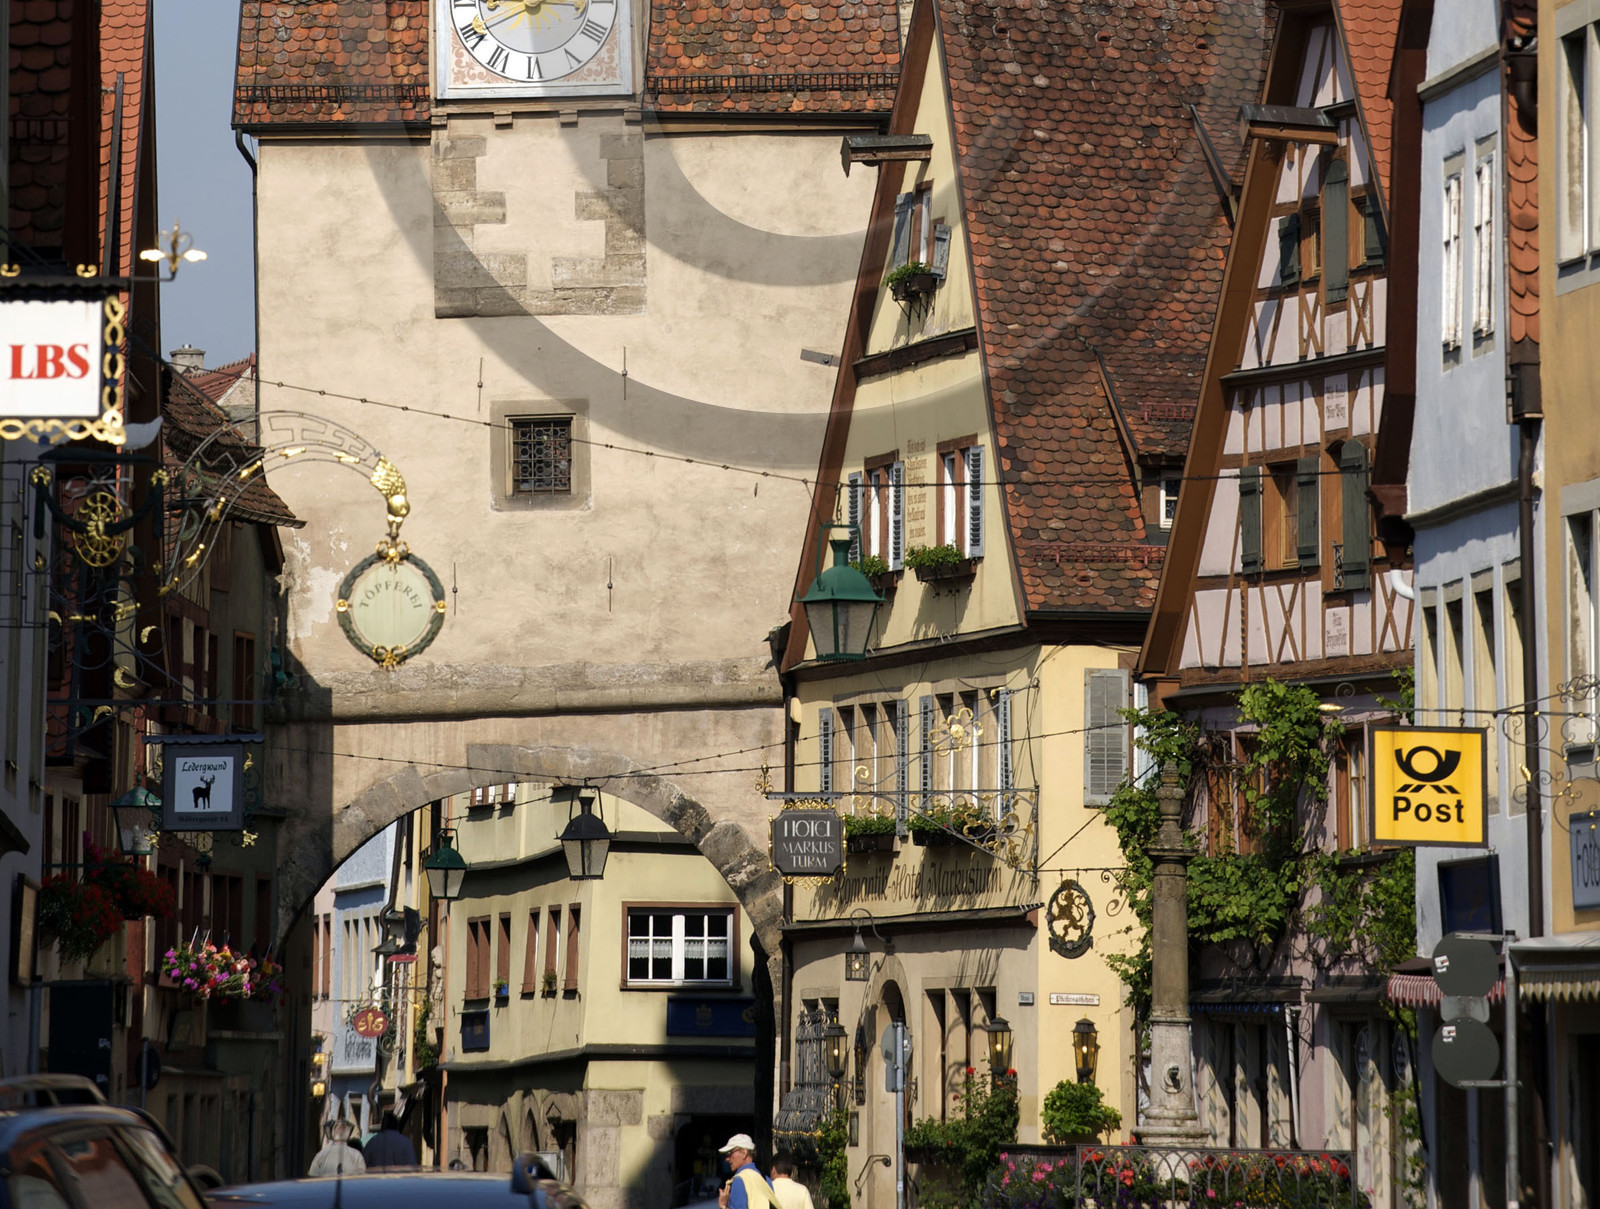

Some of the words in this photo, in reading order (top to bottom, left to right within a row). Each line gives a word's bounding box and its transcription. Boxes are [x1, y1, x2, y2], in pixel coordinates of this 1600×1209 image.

[459, 23, 487, 52] VIII
[580, 19, 608, 46] IIII
[486, 44, 511, 74] VII
[526, 56, 544, 80] VI
[563, 48, 583, 70] V
[9, 343, 90, 380] LBS
[360, 580, 424, 609] TÖPFEREI
[182, 760, 228, 774] Ledergwand
[1392, 794, 1465, 823] Post
[784, 820, 831, 838] HOTEL
[782, 840, 835, 854] MARKUS
[790, 854, 828, 868] TURM
[833, 863, 925, 905] Romantik-Hotel
[927, 860, 1003, 899] Markusturm
